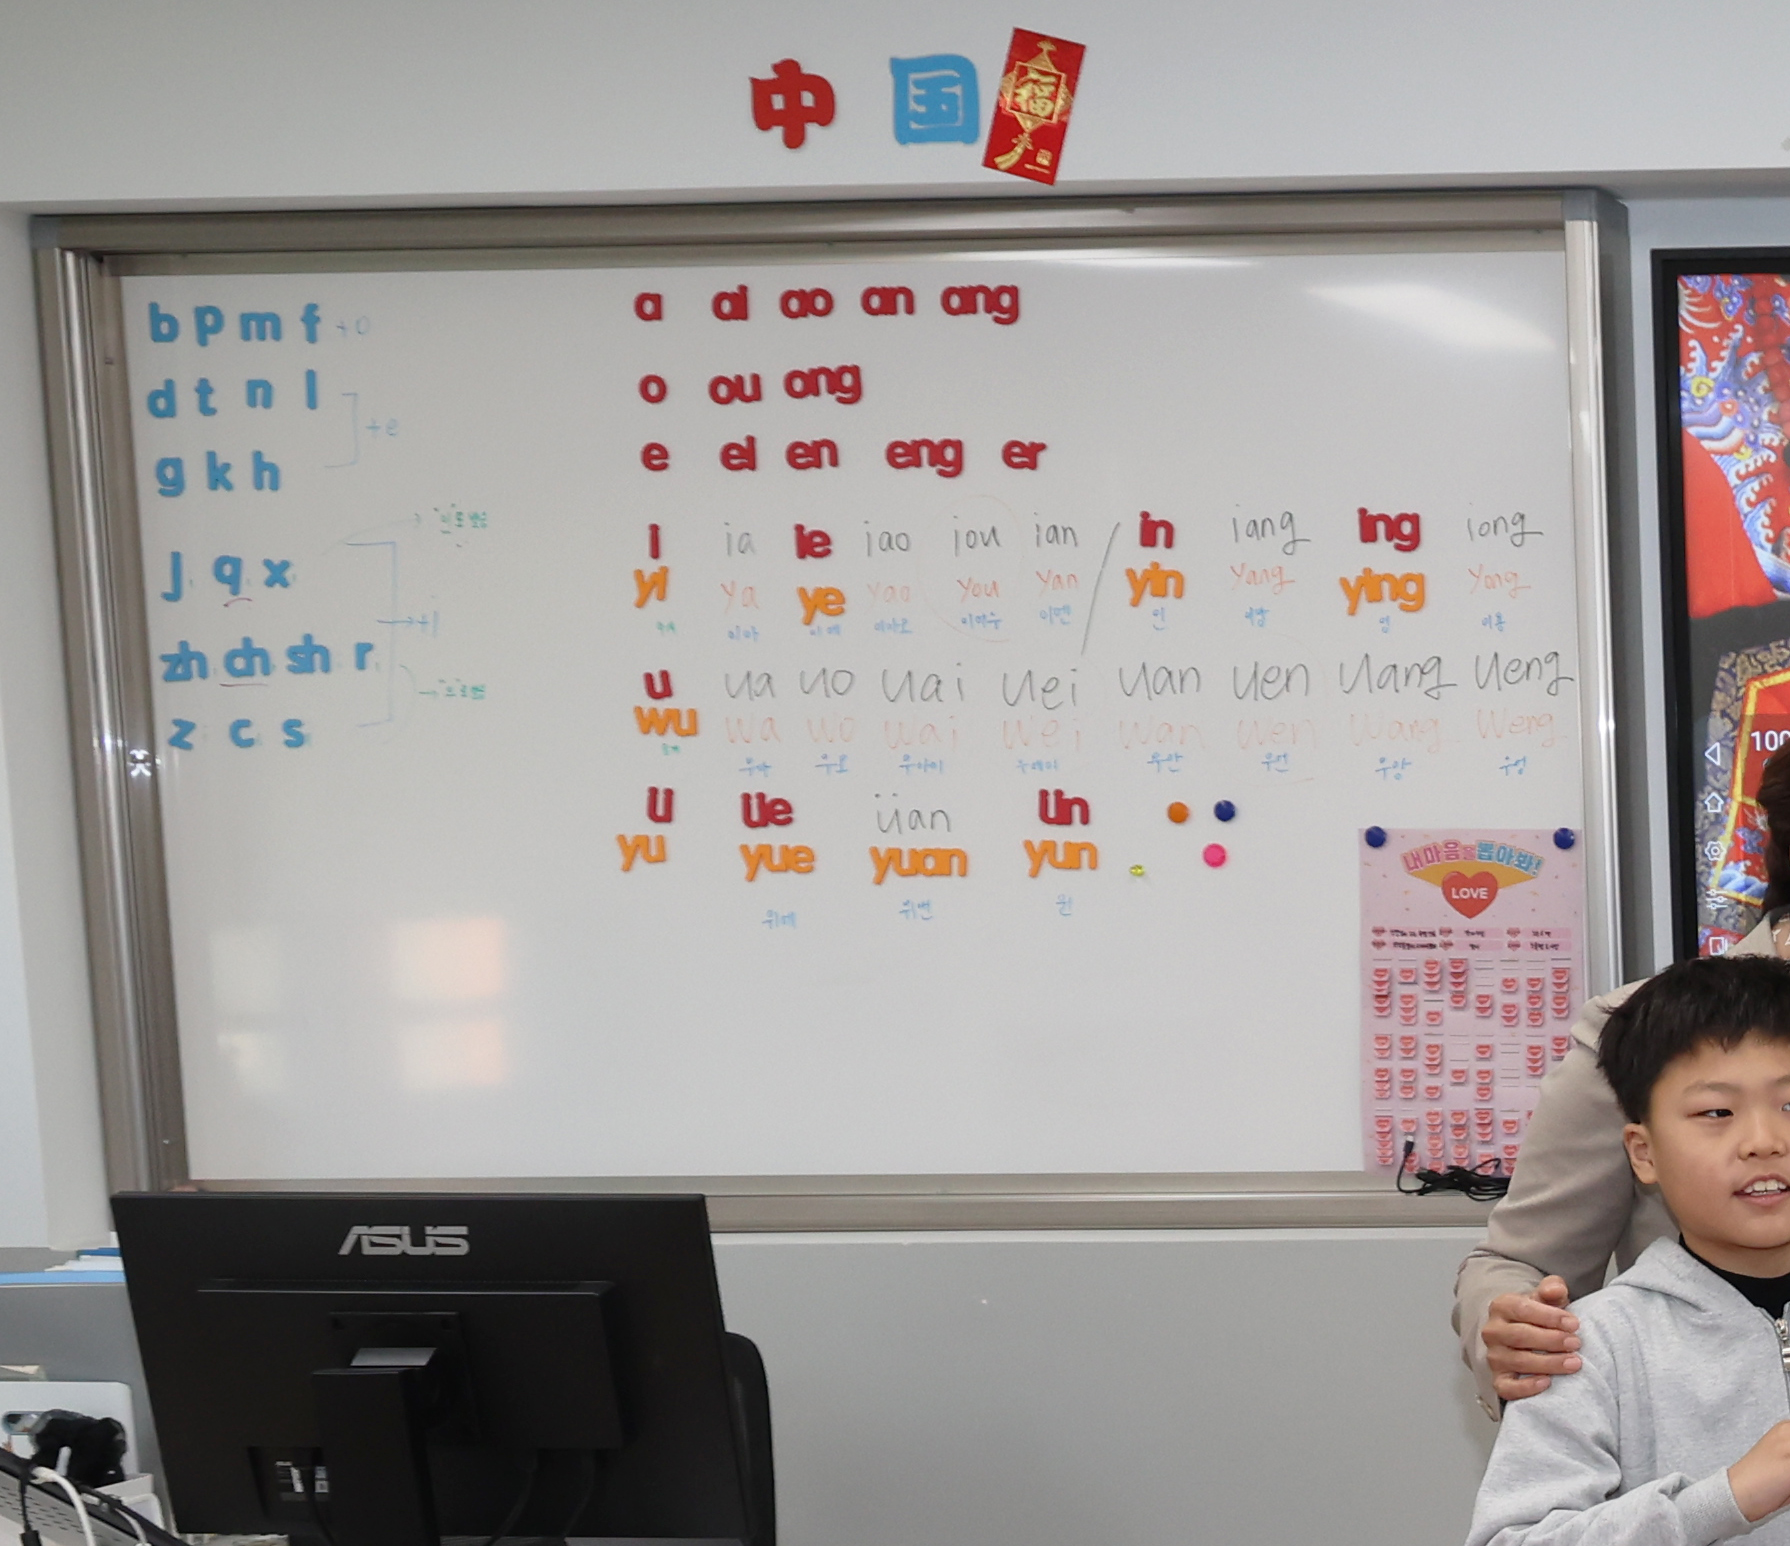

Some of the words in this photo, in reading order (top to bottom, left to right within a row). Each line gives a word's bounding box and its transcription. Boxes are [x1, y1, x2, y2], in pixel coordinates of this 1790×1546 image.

[749, 53, 981, 150] 中国
[150, 303, 179, 342] b
[195, 305, 224, 346] p
[240, 312, 281, 341] m
[302, 303, 320, 342] f
[634, 292, 663, 322] a
[780, 287, 834, 319] ao
[861, 286, 915, 316] an
[941, 284, 1020, 326] ang
[148, 379, 176, 418] d
[196, 379, 216, 415] t
[247, 379, 272, 408] n
[639, 374, 667, 404] o
[709, 373, 762, 405] ou
[784, 364, 863, 405] ong
[156, 458, 184, 496] g
[207, 451, 233, 490] k
[254, 451, 279, 491] h
[641, 442, 669, 472] e
[786, 438, 839, 470] en
[886, 438, 964, 478] eng
[1002, 440, 1047, 471] er
[723, 521, 755, 556] ia
[863, 519, 911, 556] iao
[1034, 512, 1078, 547] ian
[1140, 511, 1174, 549] in
[1231, 504, 1311, 555] iang
[1468, 502, 1543, 547] iong
[214, 556, 241, 595] q
[264, 559, 289, 587] x
[797, 586, 846, 626] ye
[1126, 561, 1185, 607] yin
[1339, 567, 1426, 616] ying
[161, 641, 208, 681] zh
[225, 637, 270, 677] ch
[287, 634, 330, 673] sh
[356, 643, 372, 670] r
[644, 670, 673, 700] u
[169, 719, 195, 749] z
[231, 719, 254, 747] c
[283, 719, 304, 747] s
[634, 706, 698, 737] wu
[616, 834, 667, 872] yu
[739, 843, 816, 882] yue
[869, 846, 968, 885] yuan
[1023, 839, 1098, 878] yun
[1451, 887, 1488, 899] LOVE
[337, 1225, 470, 1256] ASUS
